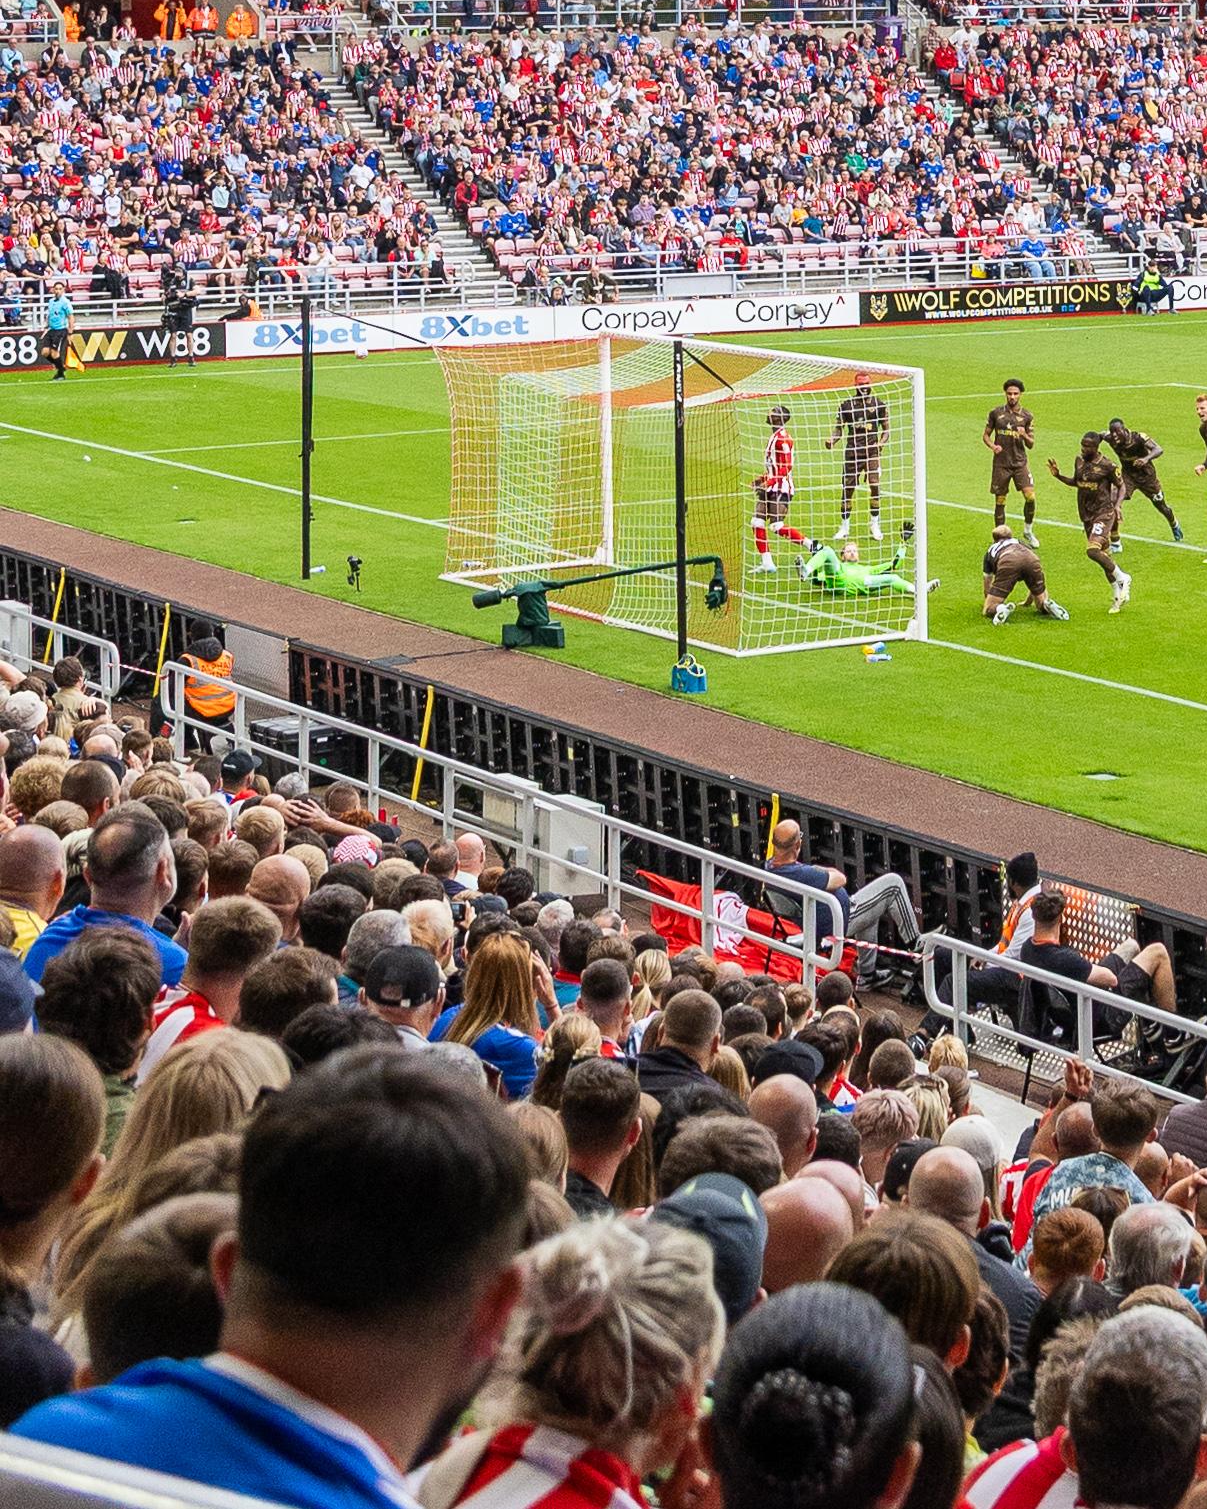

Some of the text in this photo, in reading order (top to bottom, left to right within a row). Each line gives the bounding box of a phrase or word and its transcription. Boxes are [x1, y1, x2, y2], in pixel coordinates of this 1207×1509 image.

[966, 283, 1110, 310] COMPETITIONS
[581, 306, 683, 333] Corpay
[736, 298, 834, 326] Corpay
[925, 305, 1053, 319] WWW.WOLFCOMPETITIONS.CO.UK
[252, 323, 367, 352] 8Xbet
[420, 314, 529, 342] 8Xbet
[137, 327, 211, 359] W88
